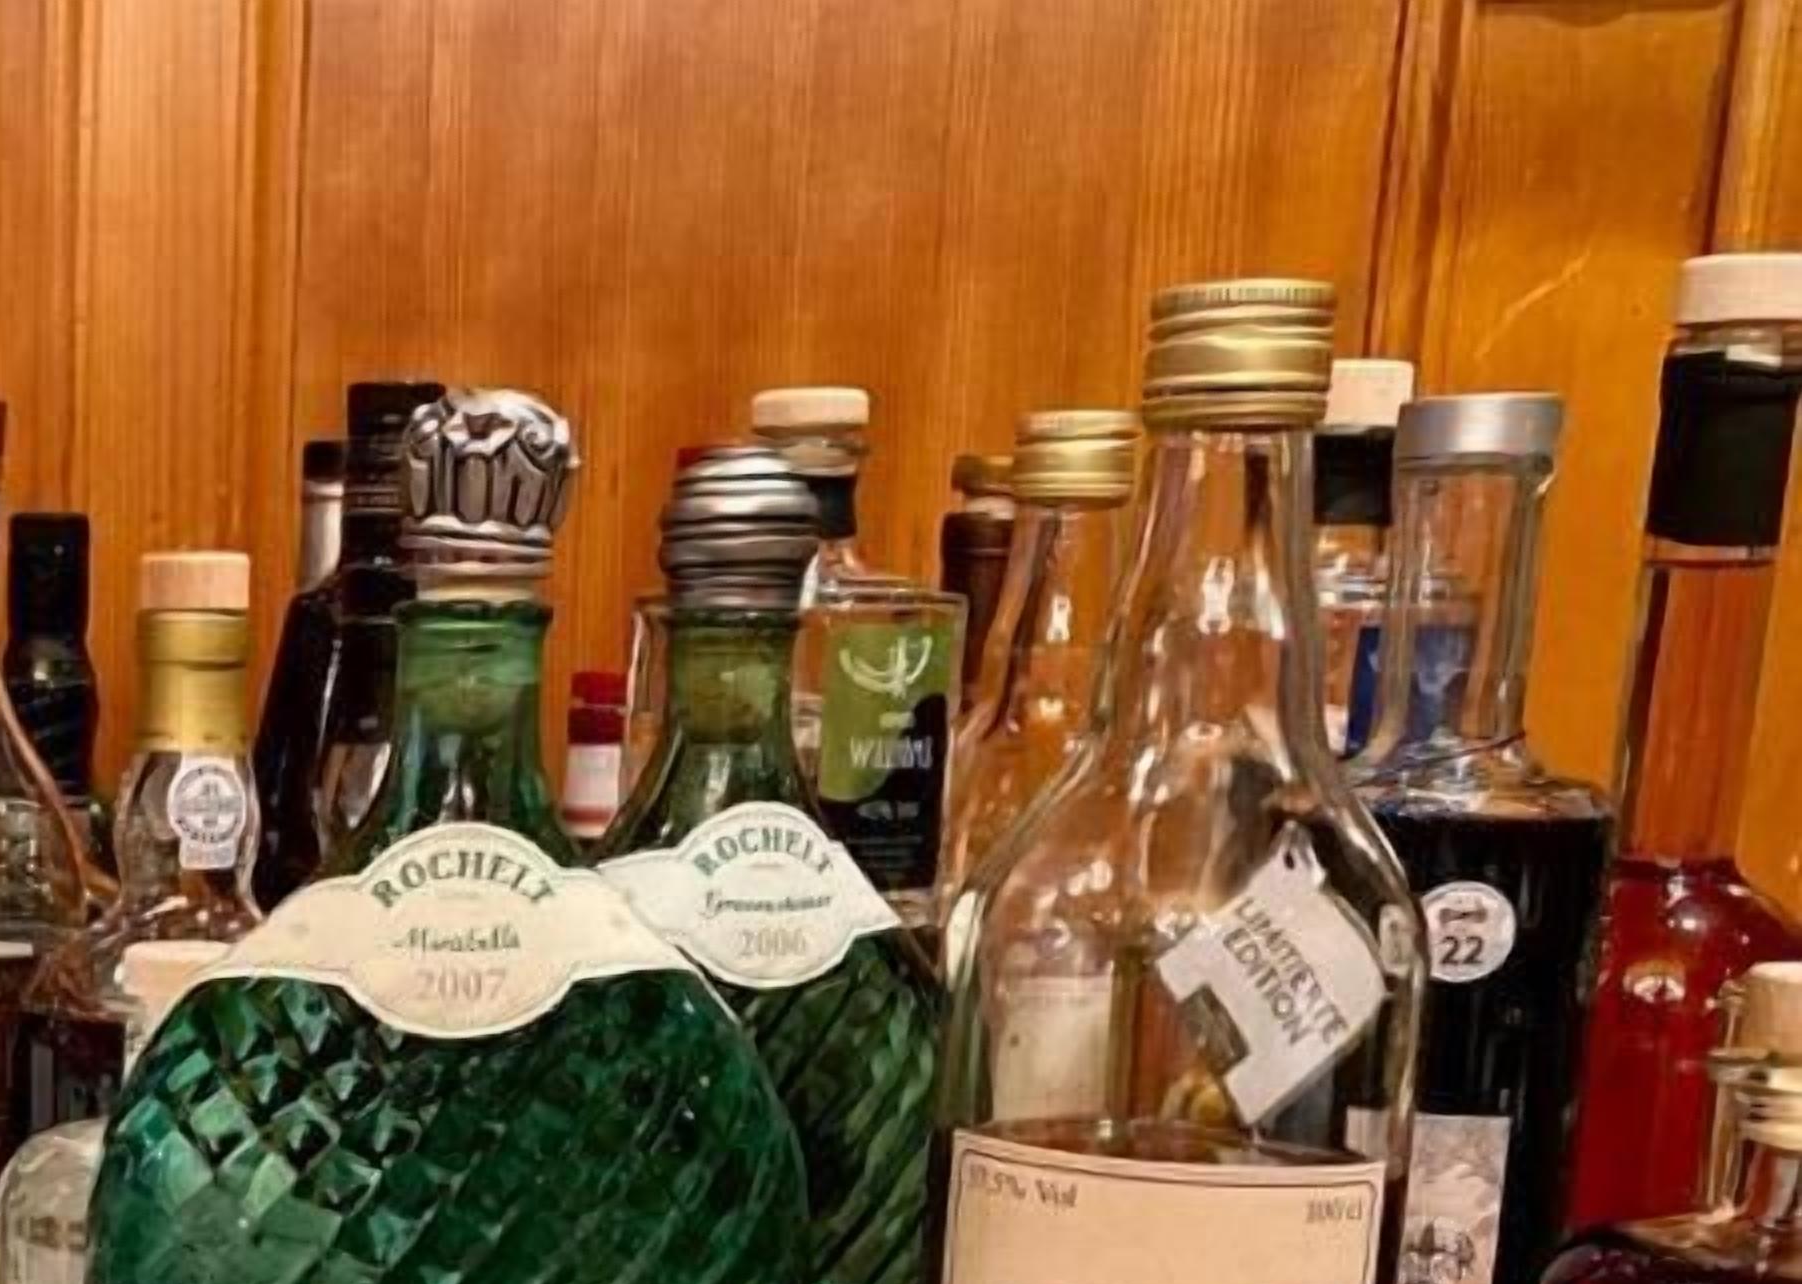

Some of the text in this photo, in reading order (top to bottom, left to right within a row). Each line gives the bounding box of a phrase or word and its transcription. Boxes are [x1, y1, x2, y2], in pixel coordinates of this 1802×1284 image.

[691, 827, 834, 877] ROCHELT
[371, 850, 553, 907] ROCHELT
[1440, 935, 1484, 966] 22
[416, 967, 508, 1001] 2007
[1221, 926, 1313, 1046] EDITION
